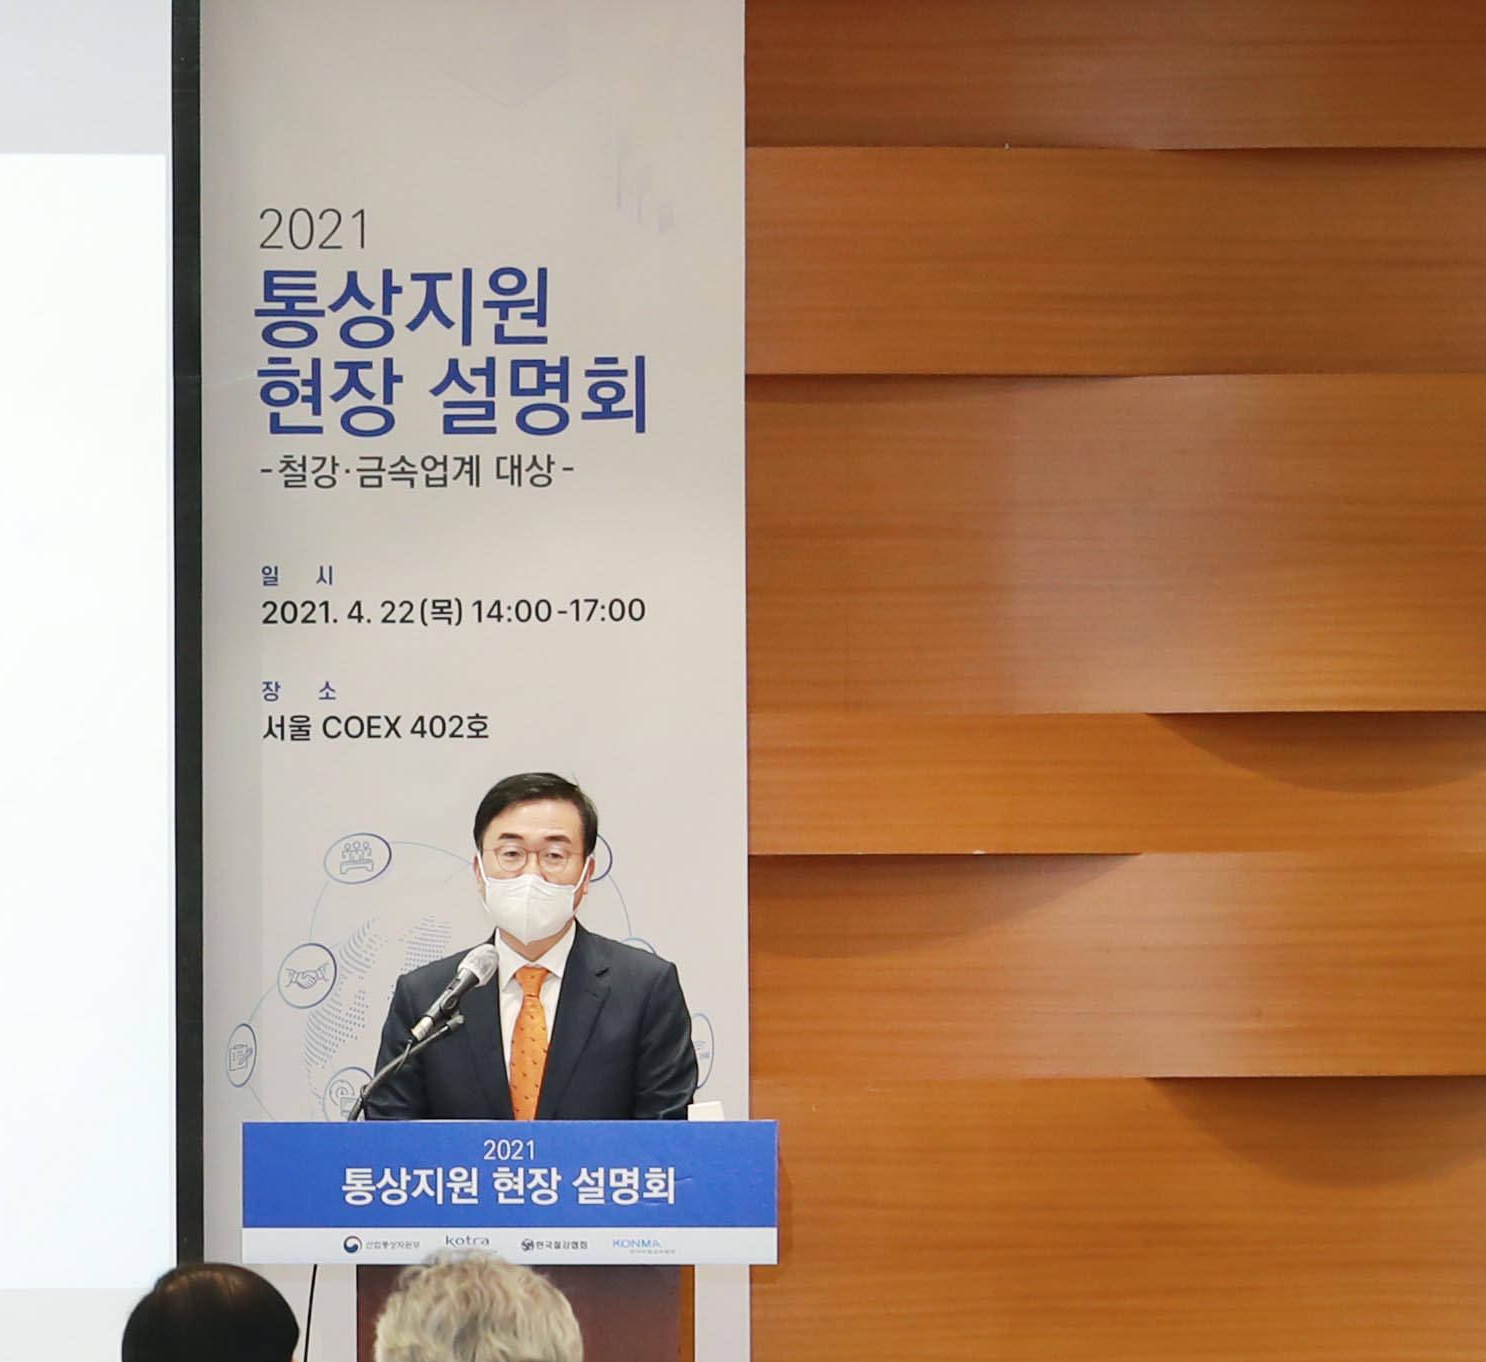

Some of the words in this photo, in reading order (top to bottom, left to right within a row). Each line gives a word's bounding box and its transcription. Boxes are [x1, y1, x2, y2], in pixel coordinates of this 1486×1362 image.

[259, 207, 365, 251] 2021
[253, 266, 549, 350] 통상지원
[256, 356, 404, 438] 현장
[428, 354, 646, 437] 설명회
[262, 600, 338, 625] 2021.
[347, 600, 372, 624] 4.
[262, 714, 312, 742] 서울
[322, 715, 402, 740] COEX
[410, 712, 489, 739] 402호
[483, 1138, 536, 1161] 2021
[341, 1166, 479, 1206] 통상지원
[492, 1166, 563, 1206] 현장
[572, 1166, 676, 1206] 설명회
[444, 1234, 491, 1249] kotra
